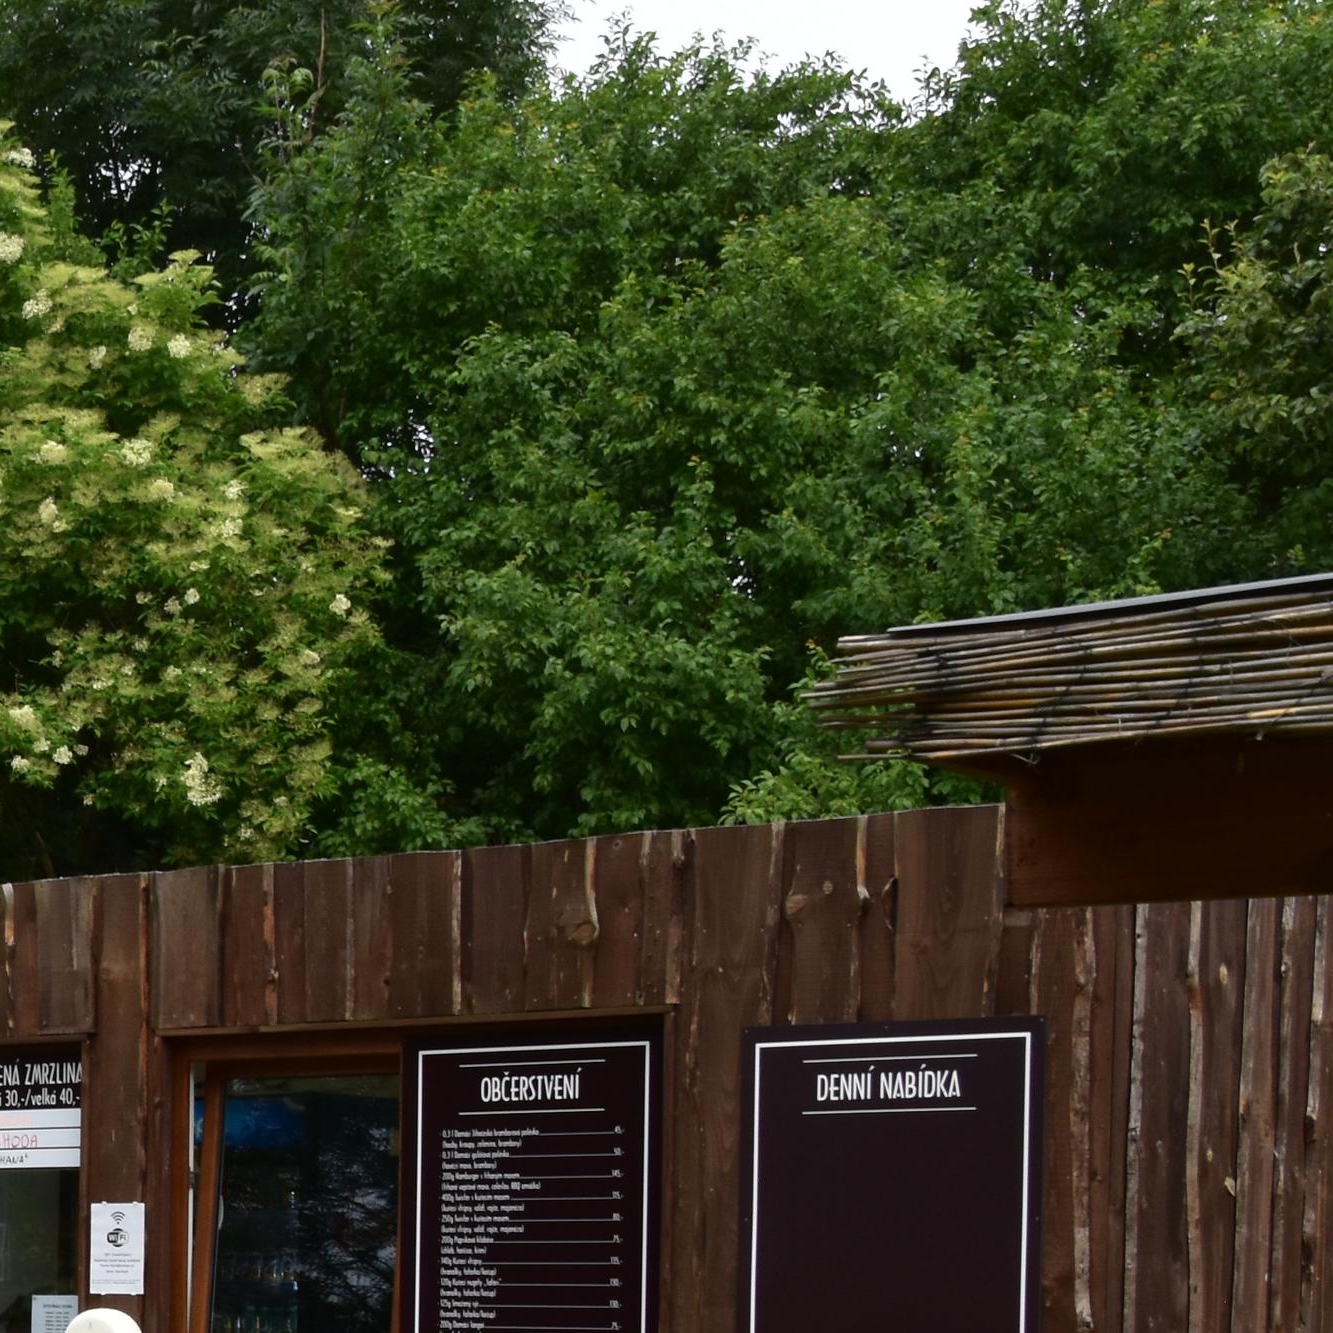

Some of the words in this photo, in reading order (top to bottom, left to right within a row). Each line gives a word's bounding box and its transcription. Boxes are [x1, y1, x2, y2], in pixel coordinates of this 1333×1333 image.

[25, 1062, 82, 1085] ZMRZLINA
[480, 1067, 582, 1102] OBČERSTVENÍ
[817, 1065, 875, 1101] DENNÍ
[880, 1063, 961, 1099] NABÍDKA
[59, 1088, 80, 1106] 40,-
